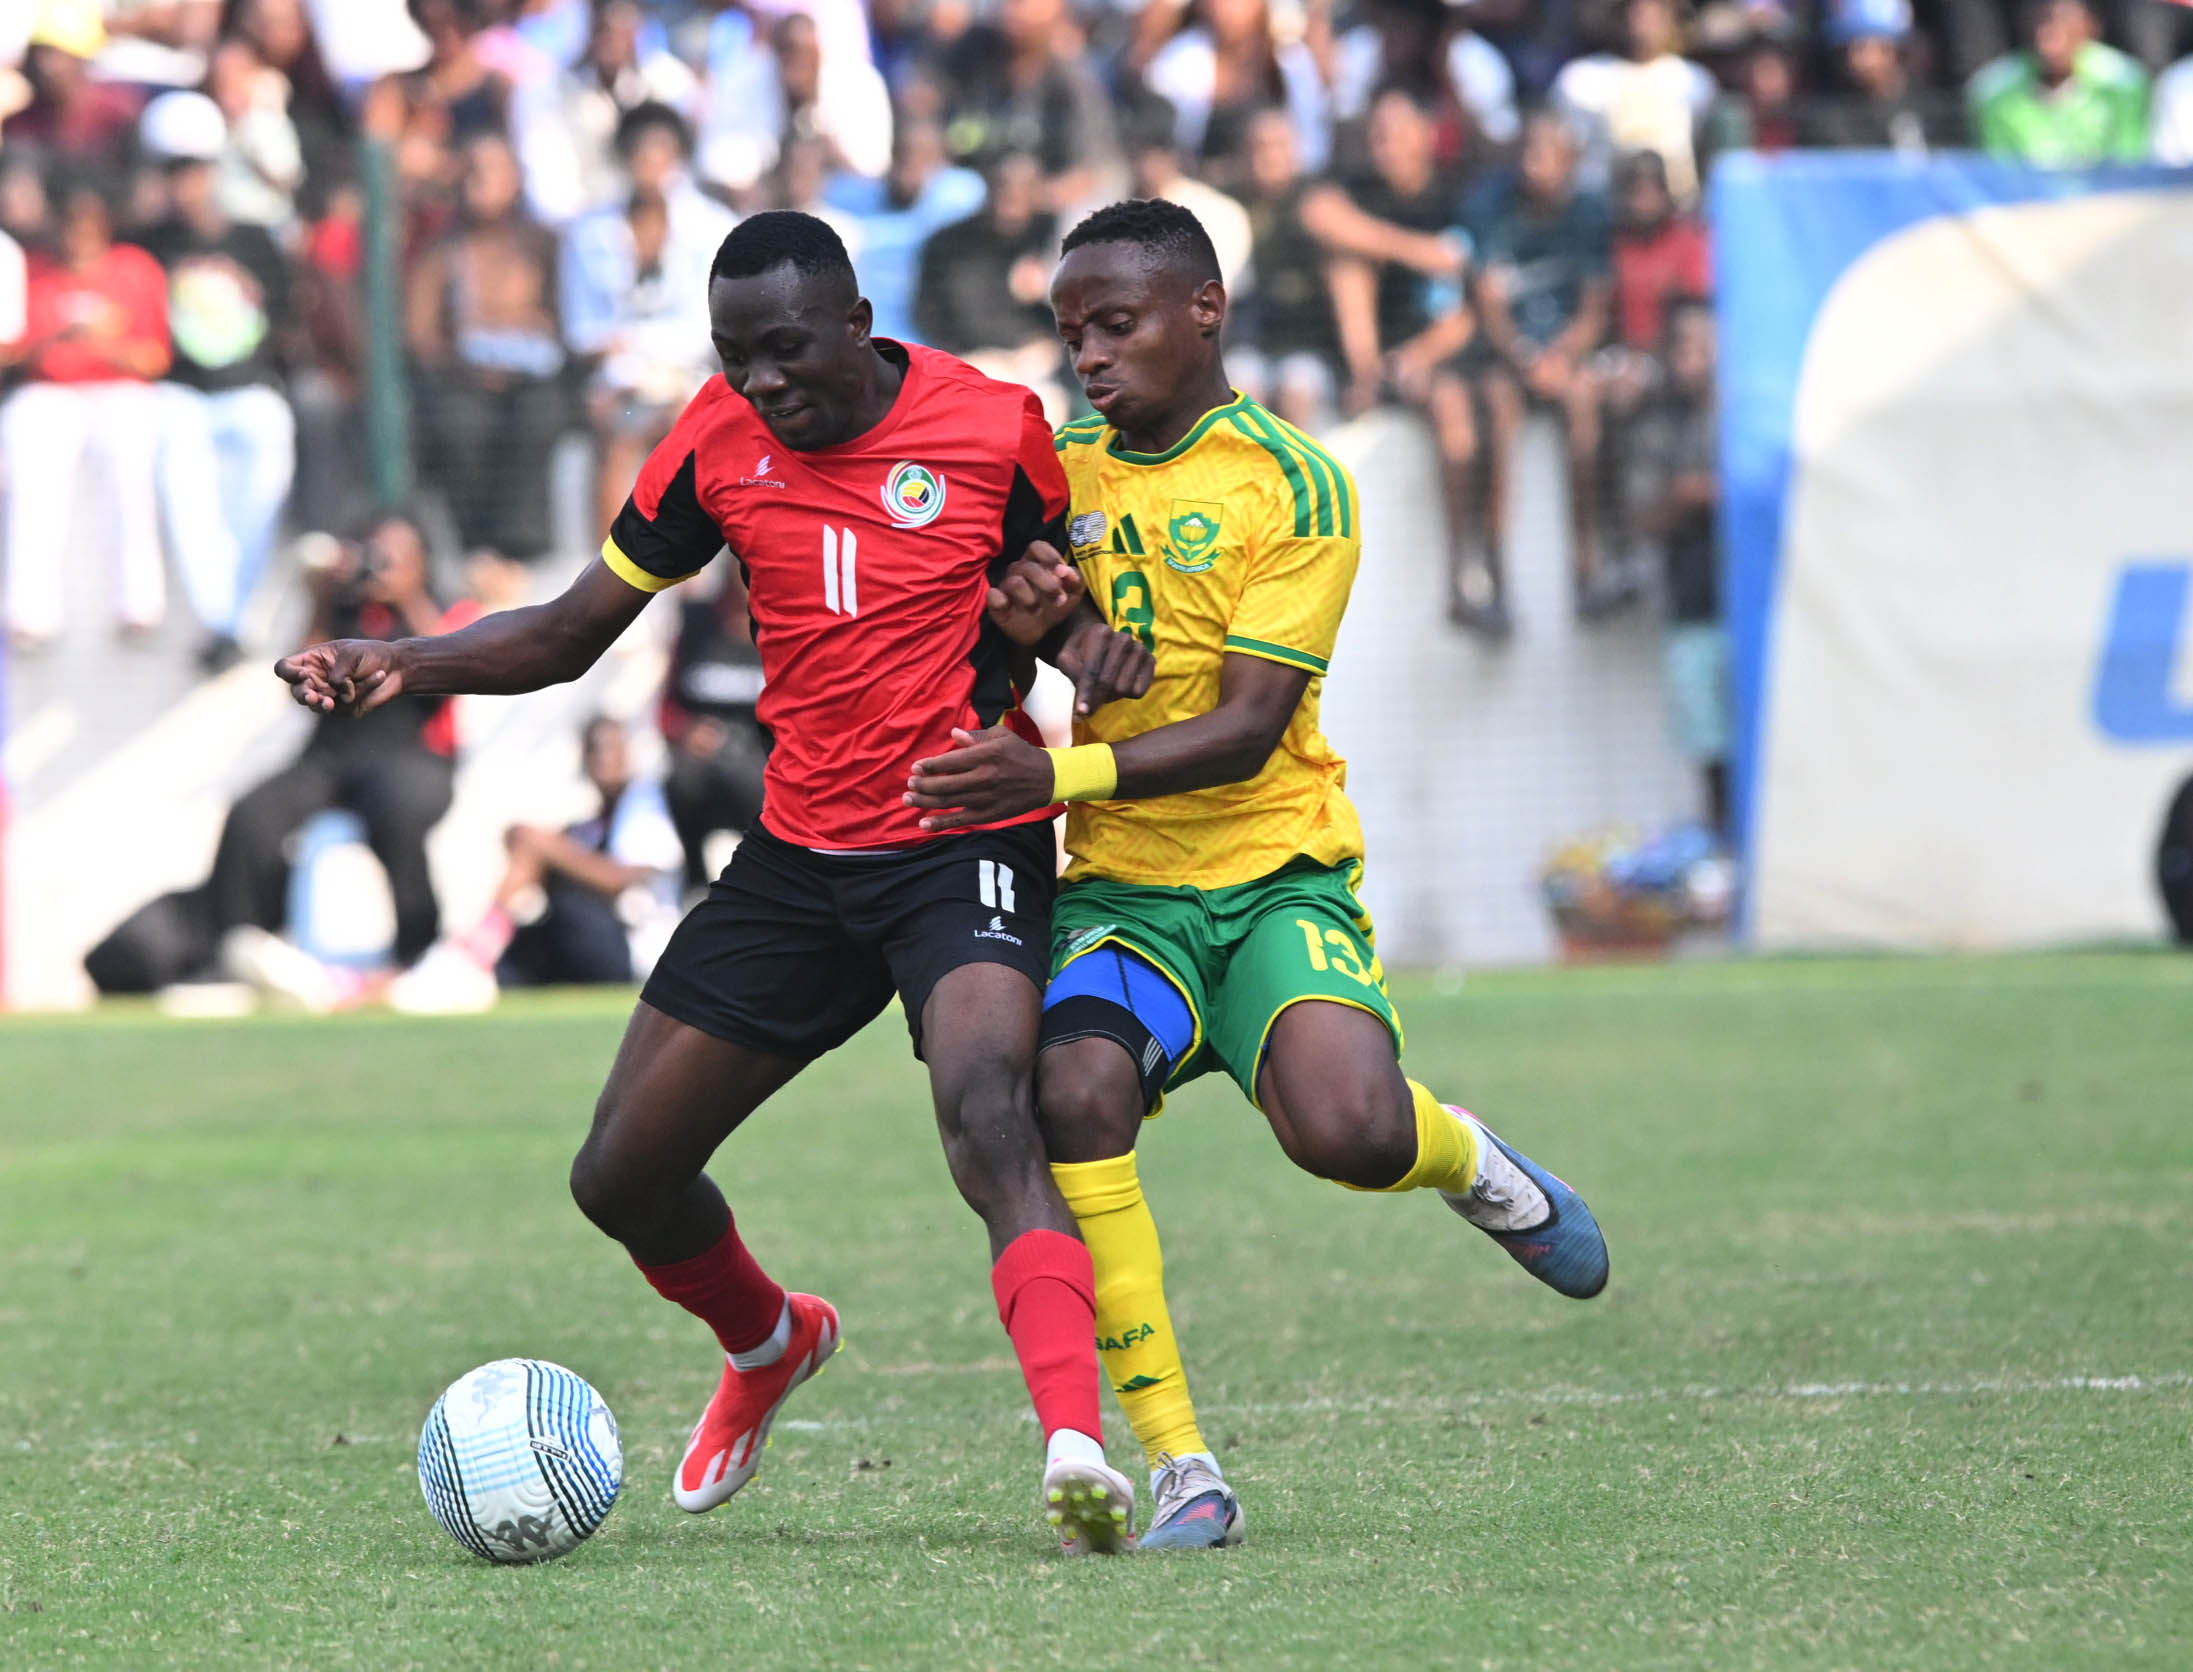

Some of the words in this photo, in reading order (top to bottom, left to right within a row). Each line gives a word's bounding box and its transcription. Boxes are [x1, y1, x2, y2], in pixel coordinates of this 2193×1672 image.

[823, 524, 857, 618] 11
[979, 859, 1015, 913] 11
[974, 929, 1023, 946] Lacatoni
[1296, 919, 1373, 987] 13
